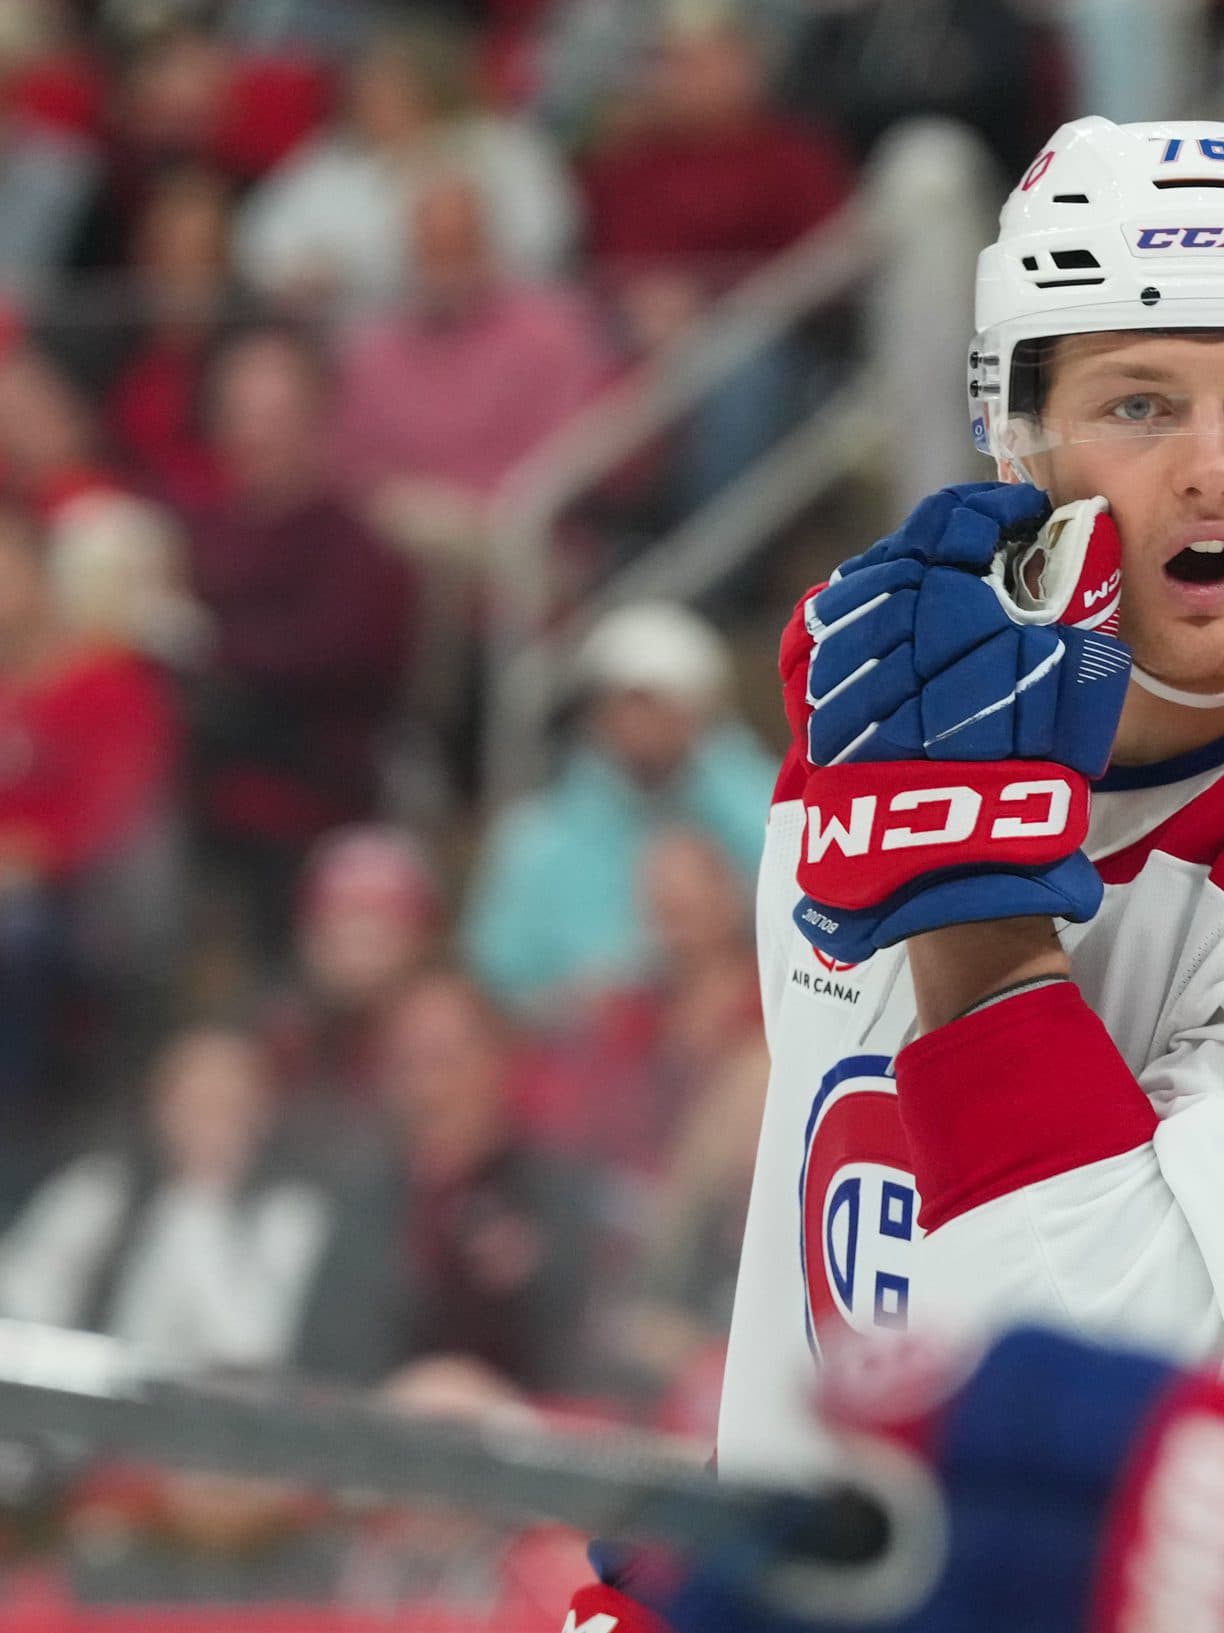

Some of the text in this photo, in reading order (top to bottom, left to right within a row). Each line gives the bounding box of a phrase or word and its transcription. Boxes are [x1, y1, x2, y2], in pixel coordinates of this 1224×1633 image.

[806, 779, 1072, 864] CCM
[802, 908, 839, 934] BOLDUC
[792, 968, 860, 1004] AIR CANA
